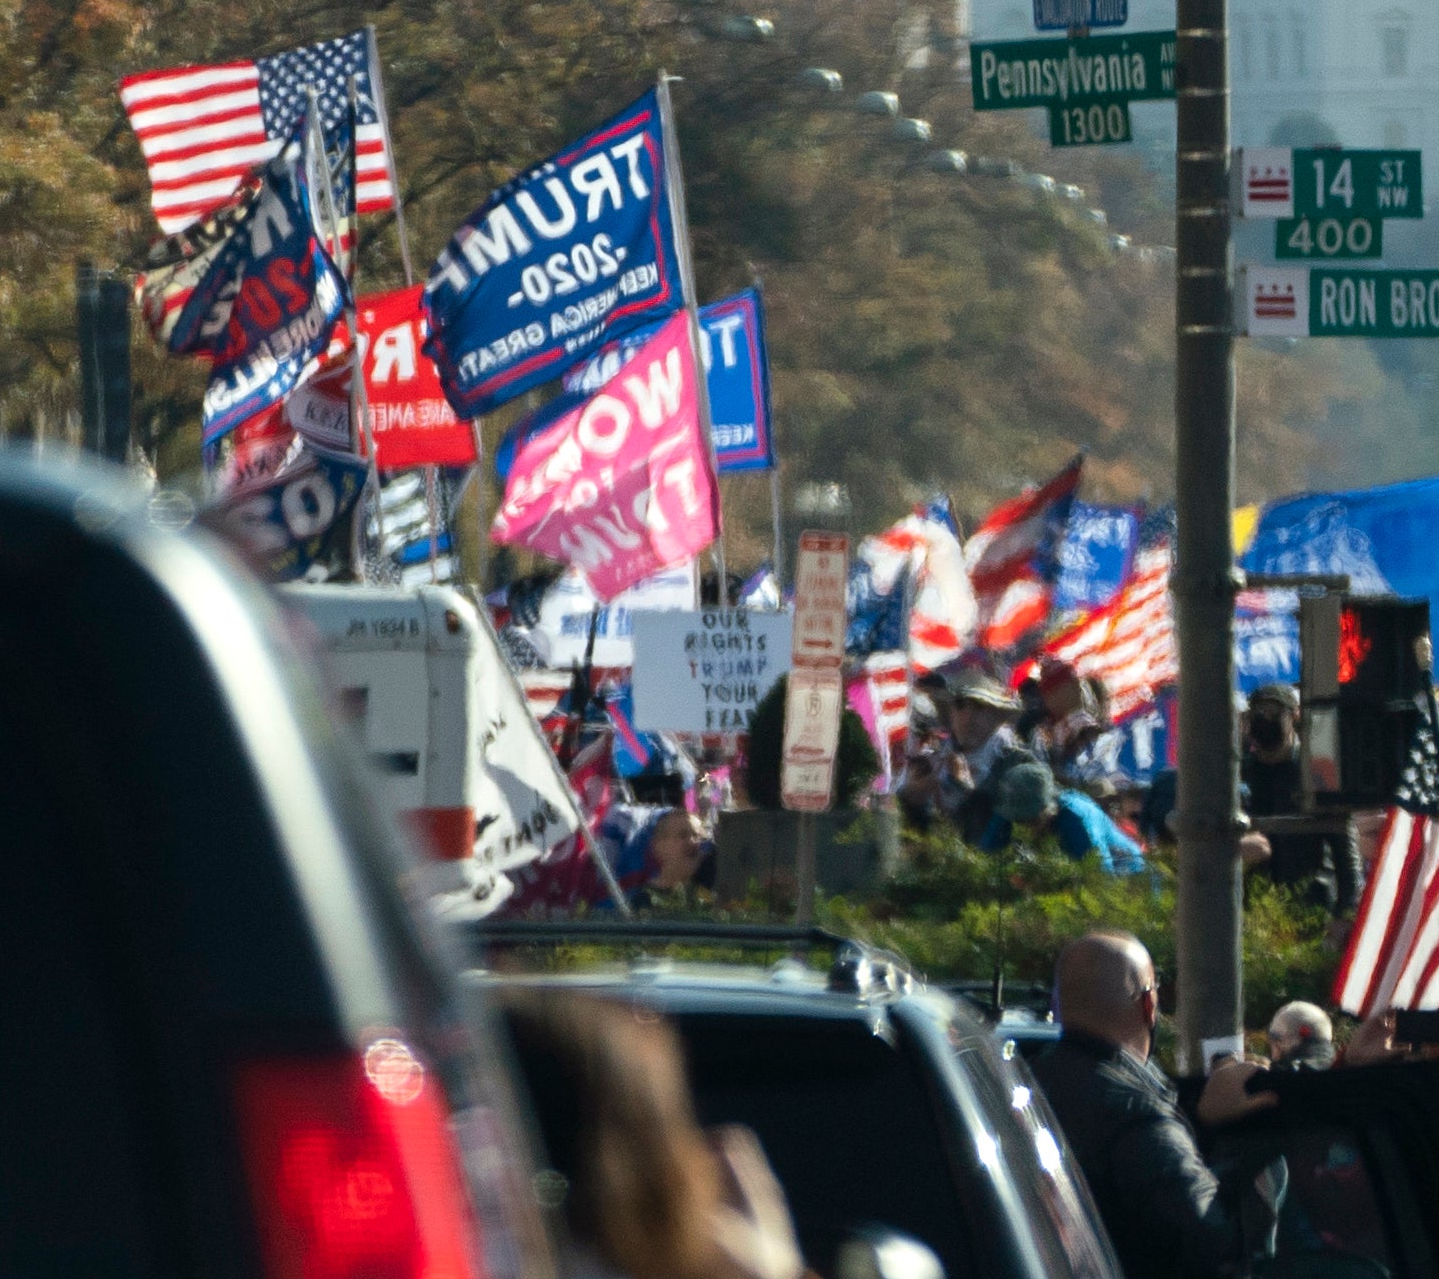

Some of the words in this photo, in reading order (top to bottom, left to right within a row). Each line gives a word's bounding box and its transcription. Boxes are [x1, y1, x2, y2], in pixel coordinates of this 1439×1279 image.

[981, 39, 1147, 101] Pennsylvania
[1063, 103, 1126, 144] 1300
[1313, 158, 1356, 209] 14
[1380, 159, 1406, 183] ST
[1376, 185, 1410, 209] NW
[1288, 217, 1373, 255] 400
[1321, 277, 1378, 328] RON
[702, 609, 750, 632] OUR
[684, 633, 768, 655] RIGHTS
[688, 656, 768, 679] TRUMP
[700, 682, 759, 705] YOUR
